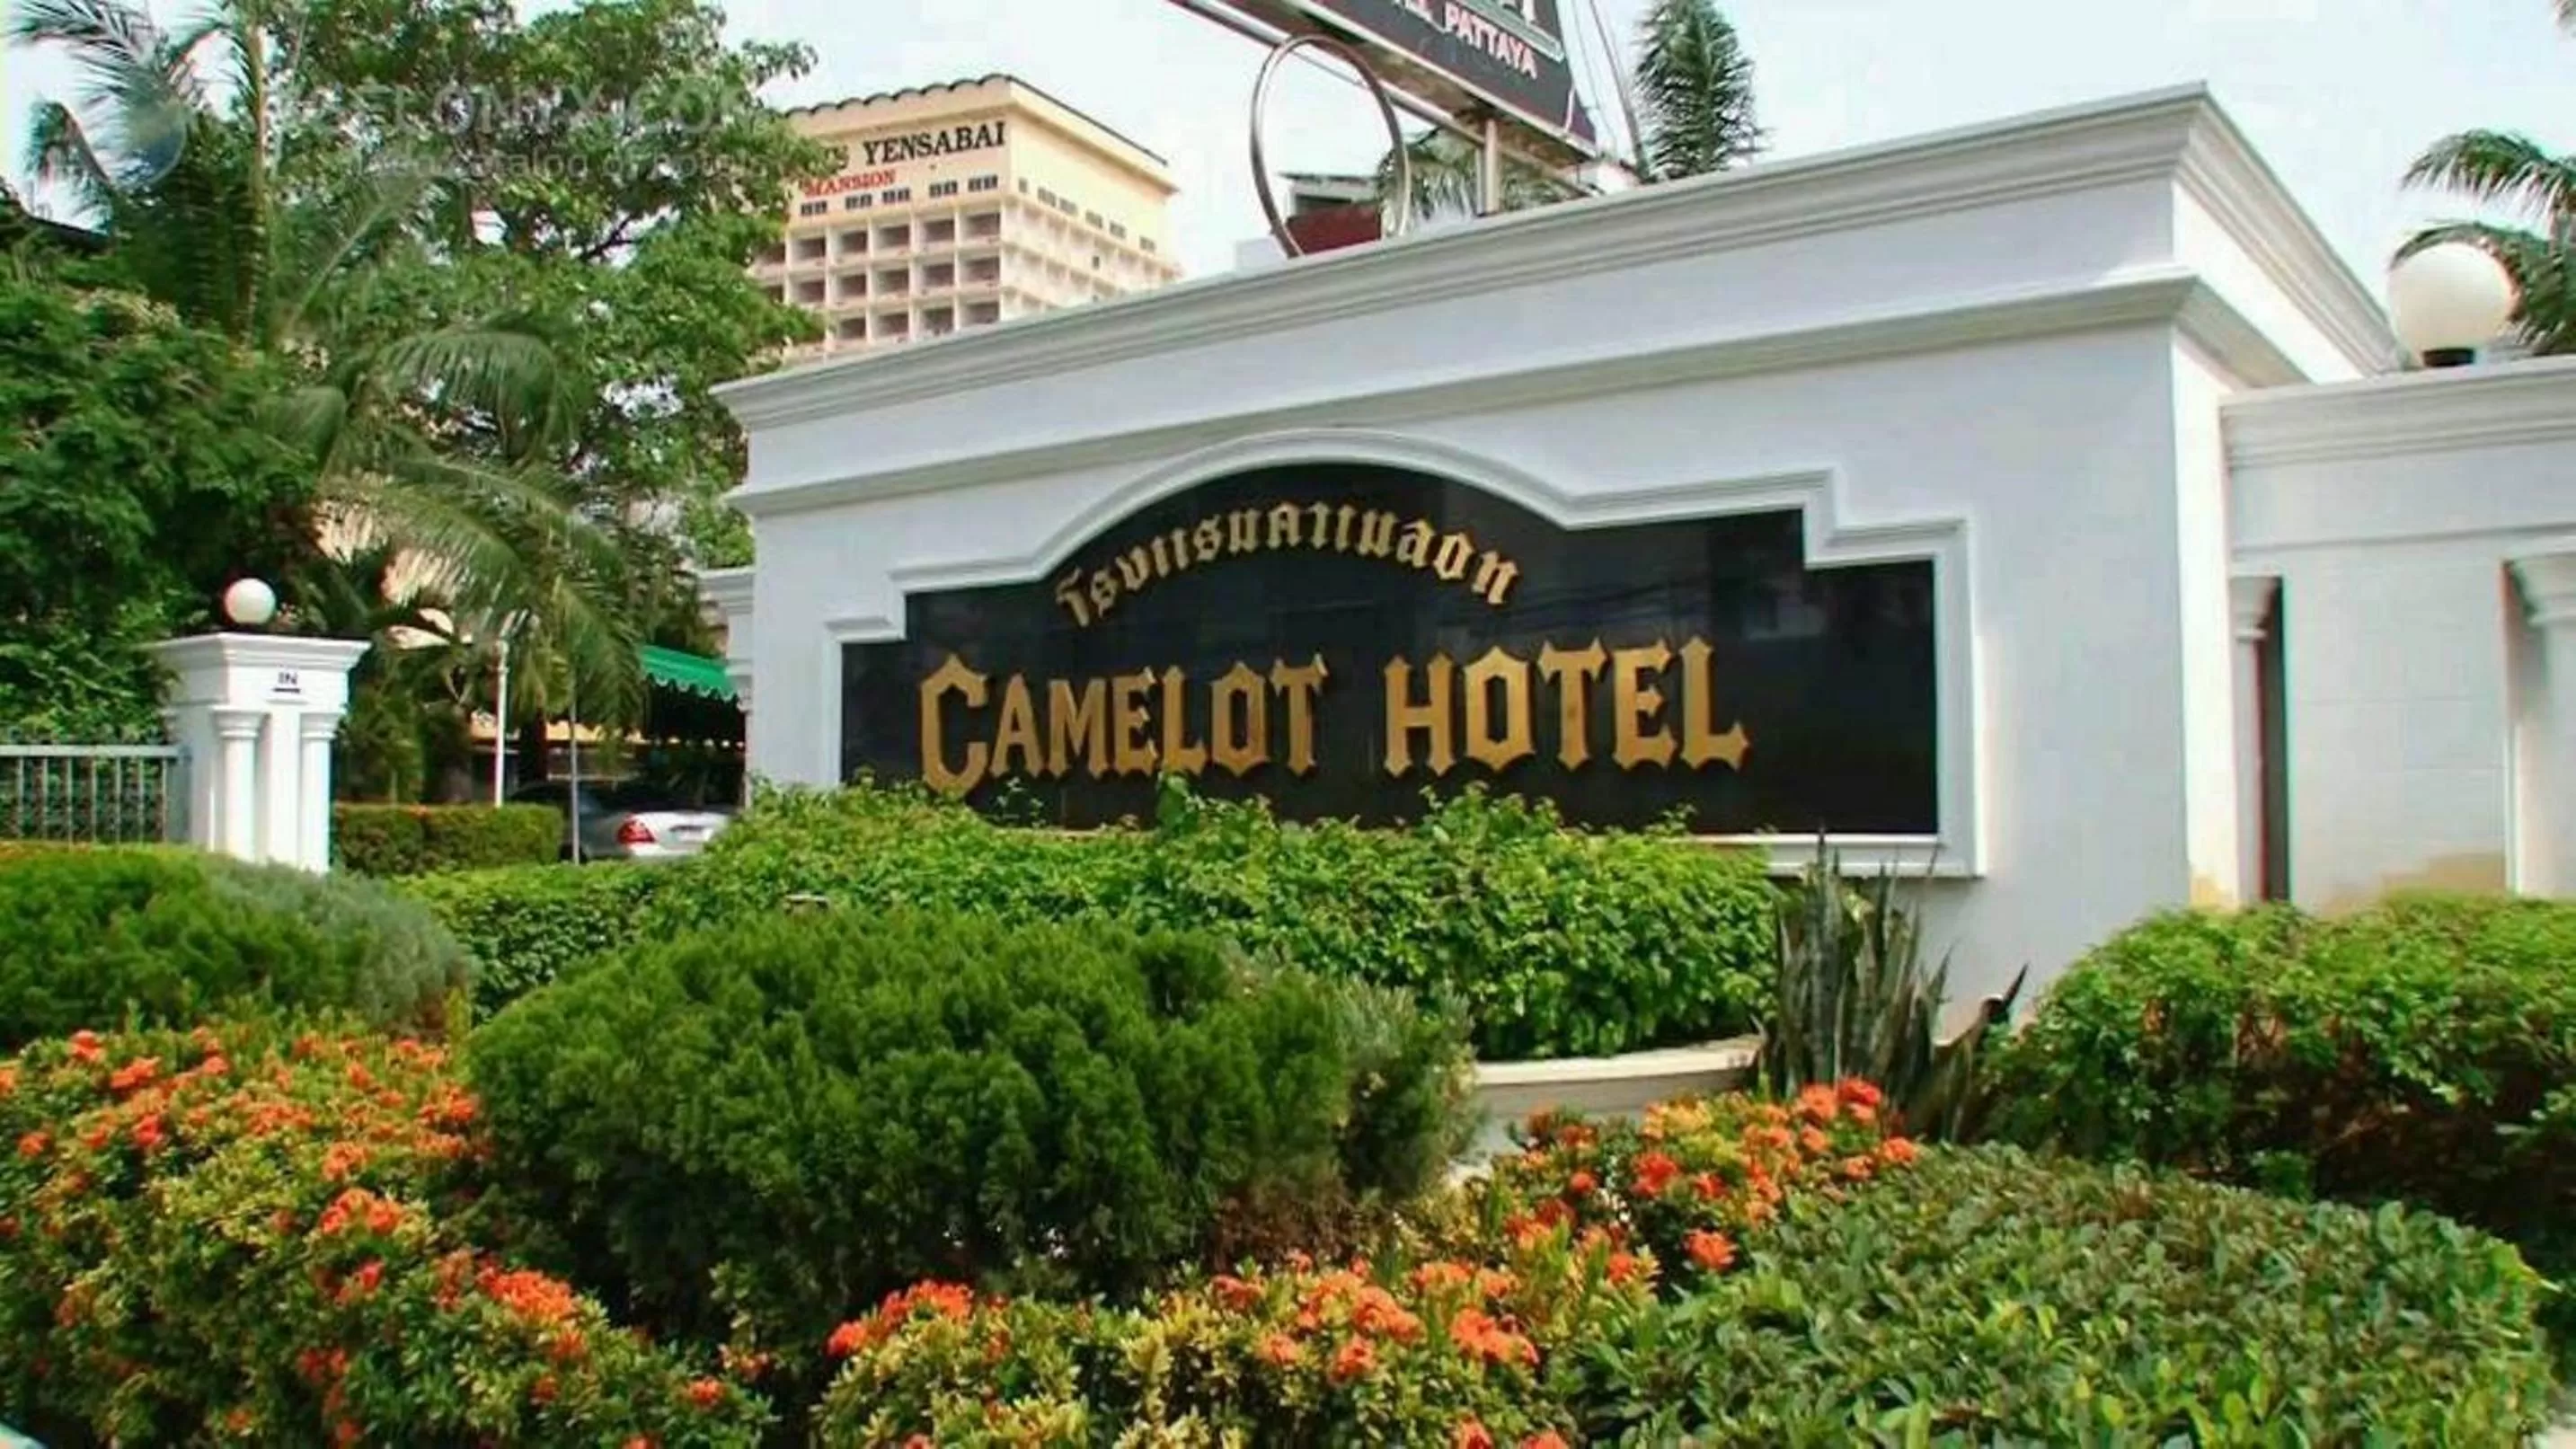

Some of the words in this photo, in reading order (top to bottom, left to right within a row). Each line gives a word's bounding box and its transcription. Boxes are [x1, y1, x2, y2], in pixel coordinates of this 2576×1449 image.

[1444, 2, 1538, 81] PATTAYA
[863, 121, 1006, 166] YENSABAI
[801, 169, 896, 198] MANSION
[278, 671, 298, 685] IN
[920, 652, 1328, 796] CAMELOT
[1383, 634, 1750, 778] HOTEL
